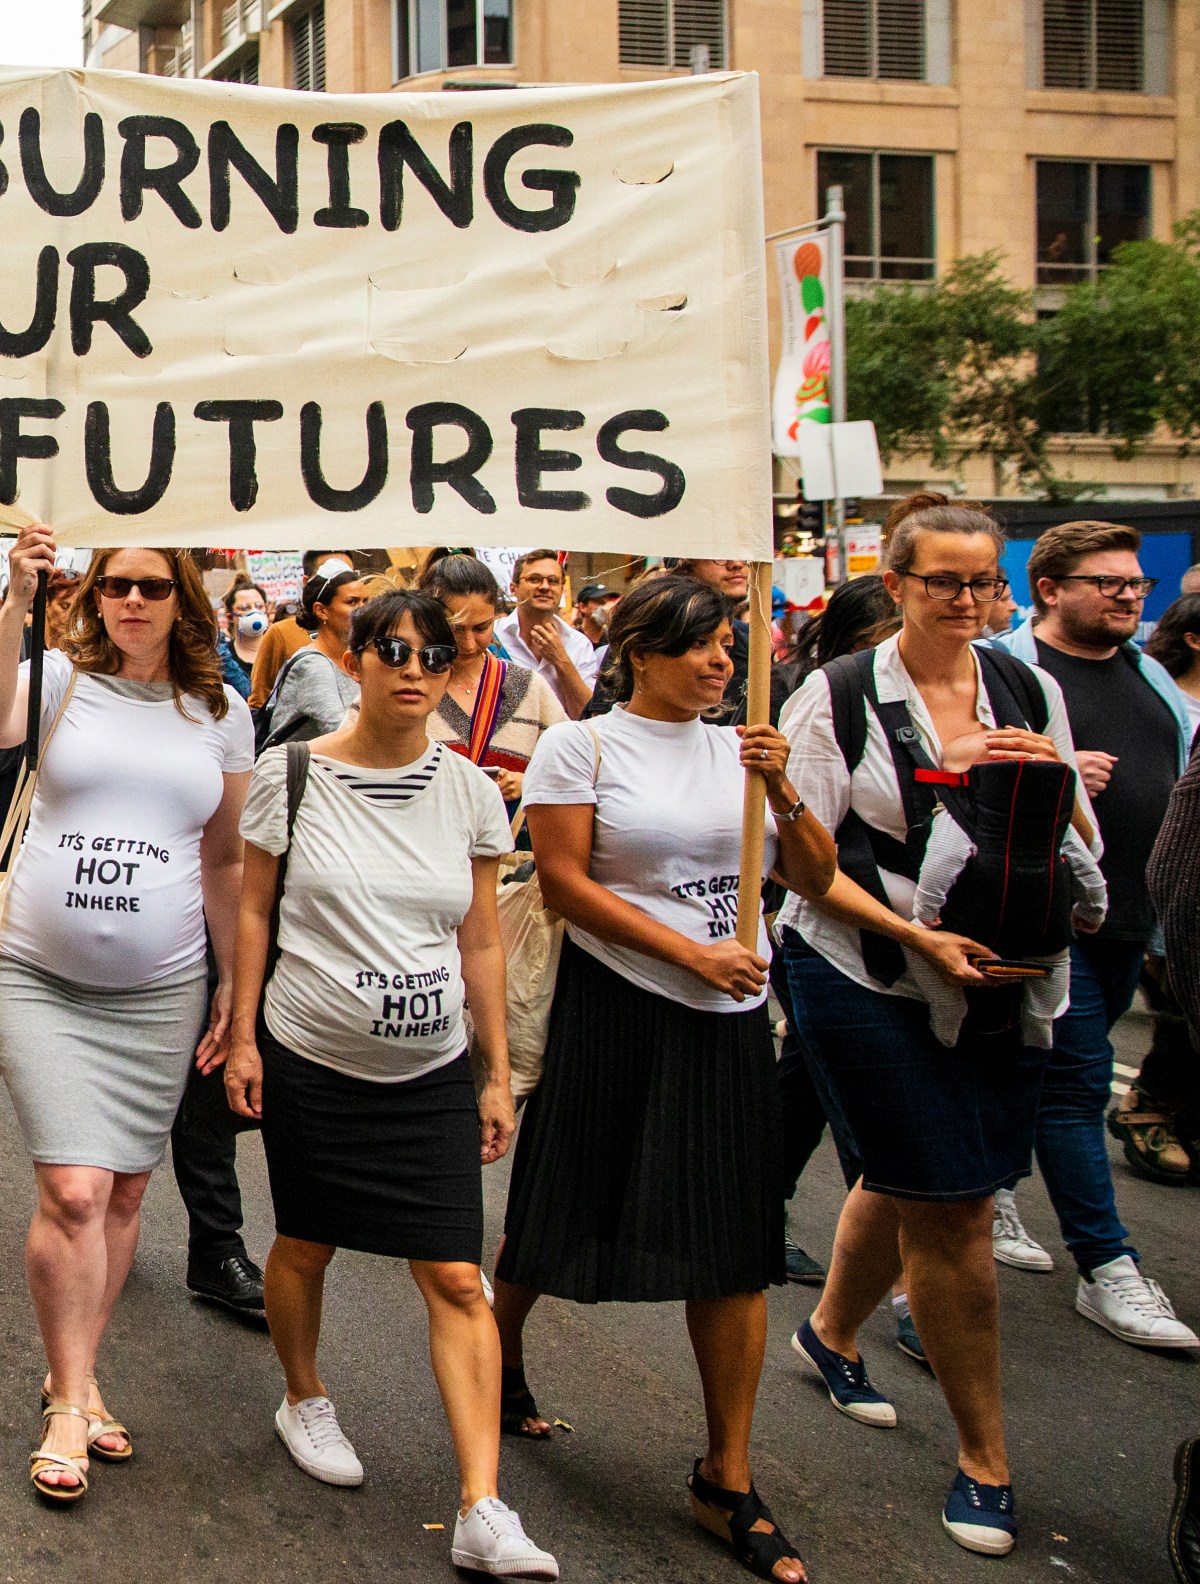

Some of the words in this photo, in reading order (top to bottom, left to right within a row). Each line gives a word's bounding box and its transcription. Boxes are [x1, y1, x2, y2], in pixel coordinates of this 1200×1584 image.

[58, 831, 85, 851] IT'S
[91, 836, 170, 864] GETTING
[75, 857, 140, 886] HOT
[671, 879, 706, 899] IT'S
[65, 891, 88, 909] IN
[90, 895, 140, 913] HERE
[704, 893, 738, 919] HO
[707, 919, 730, 937] IN
[355, 970, 389, 989] IT'S
[392, 966, 450, 990] GETTING
[382, 988, 443, 1021] HOT
[369, 1020, 402, 1038] IN
[405, 1015, 450, 1038] HERE
